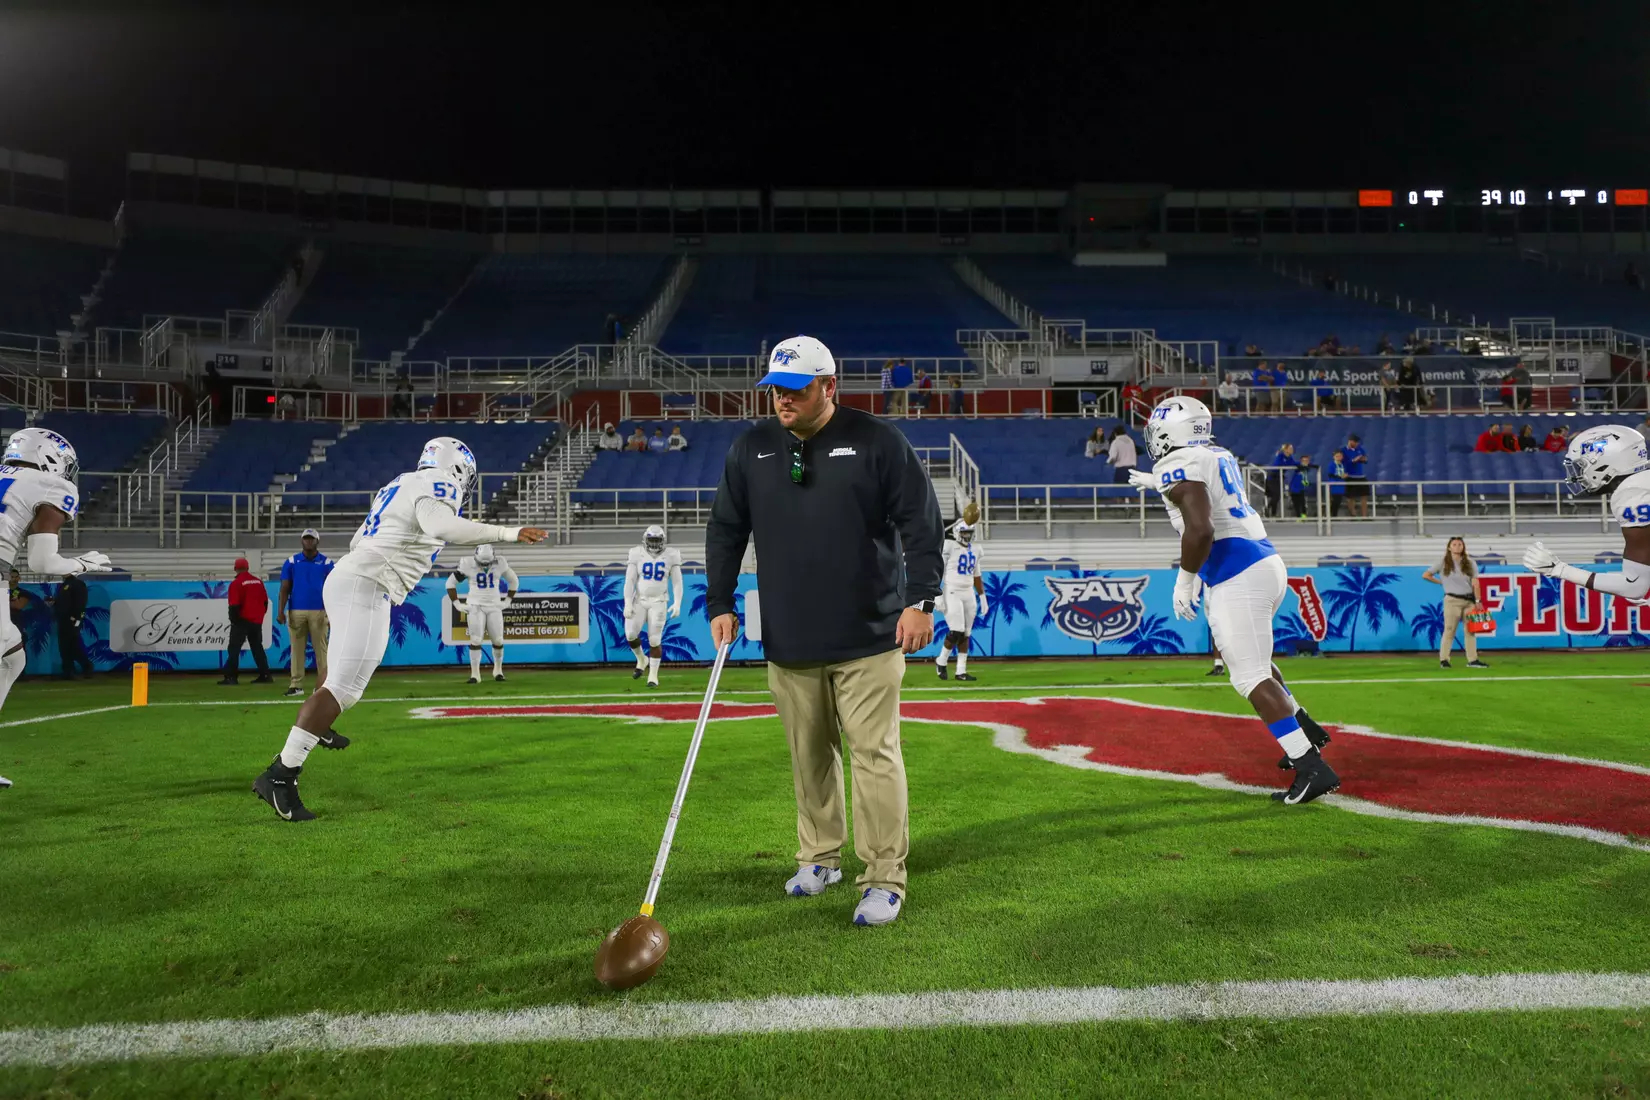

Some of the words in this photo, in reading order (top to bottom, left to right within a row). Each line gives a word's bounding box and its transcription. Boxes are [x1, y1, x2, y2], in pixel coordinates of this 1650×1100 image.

[1408, 191, 1418, 205] 0
[1481, 190, 1502, 206] 39
[1510, 190, 1526, 206] 10
[1597, 190, 1608, 204] 0
[1343, 369, 1379, 384] Sport
[1193, 425, 1203, 434] 99
[1162, 468, 1187, 484] 99
[433, 482, 458, 501] 57
[1622, 504, 1650, 523] 49
[642, 561, 665, 581] 96
[1054, 580, 1144, 605] FAU
[1299, 585, 1322, 634] ATLANTIC
[537, 626, 568, 636] (6673)
[167, 636, 195, 645] Events
[196, 636, 202, 644] &
[205, 636, 226, 646] Party
